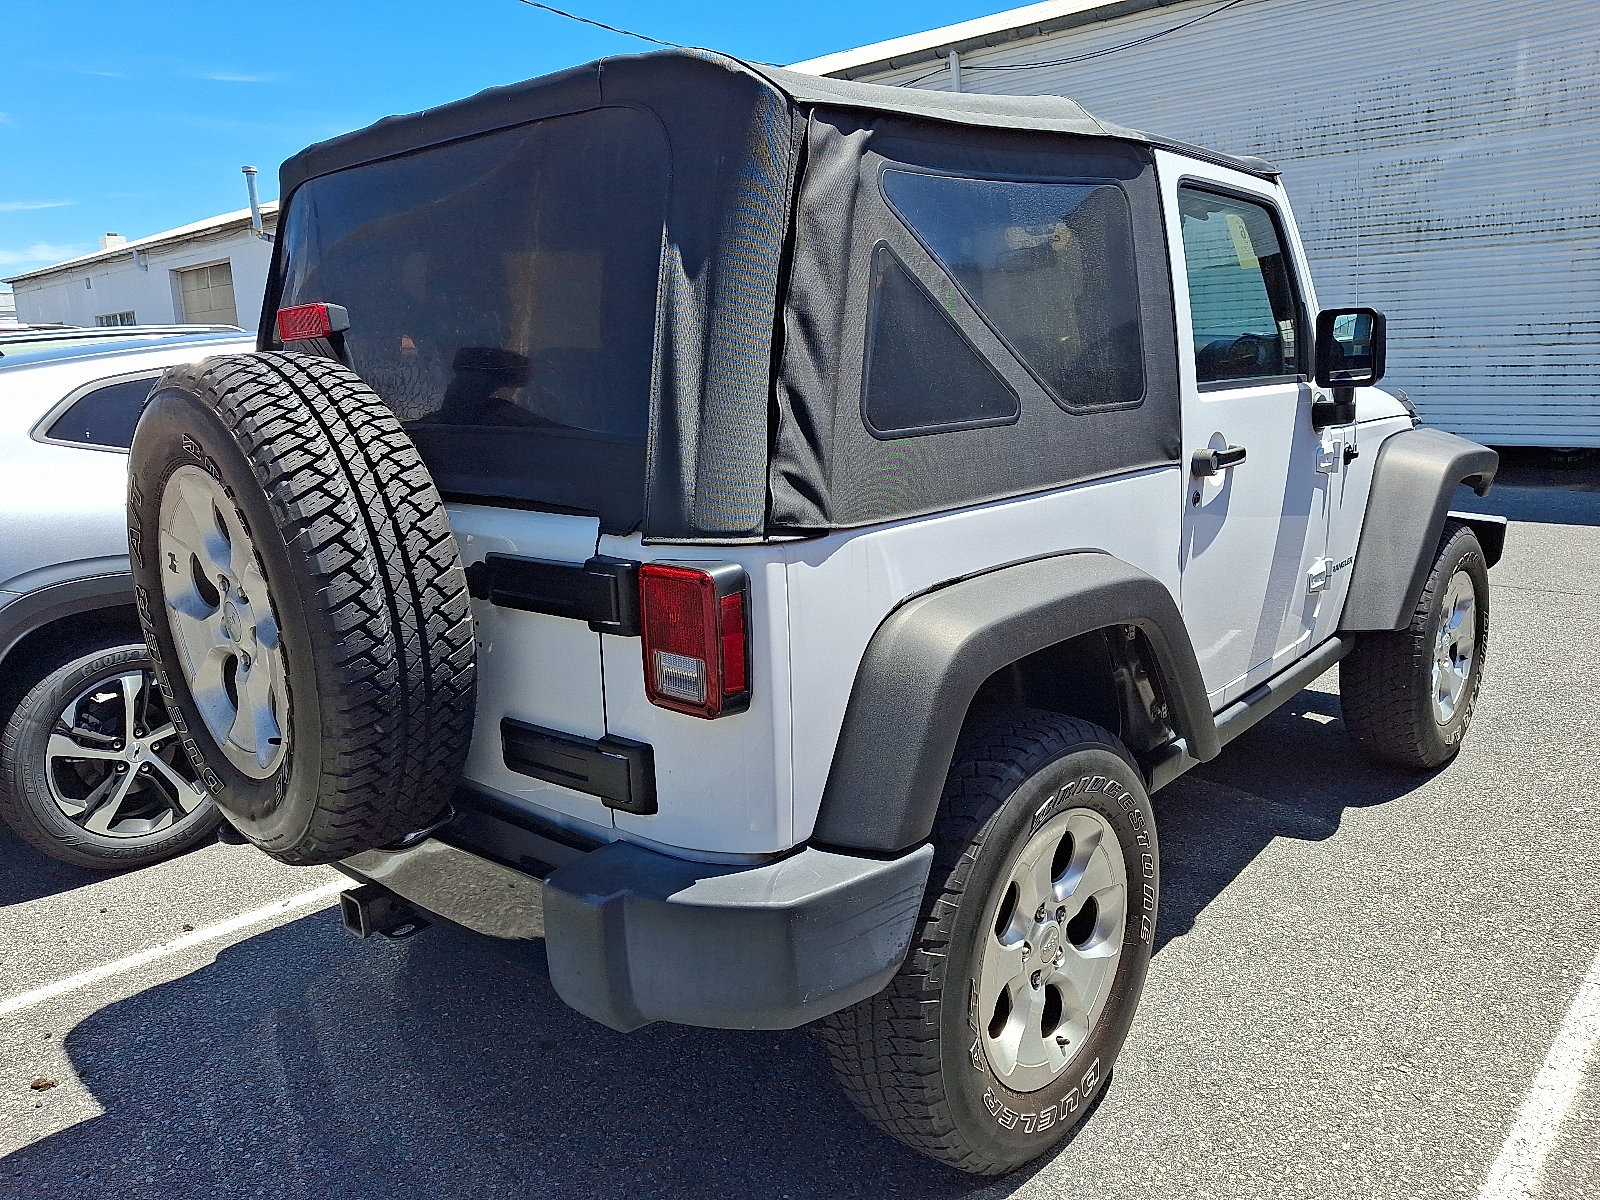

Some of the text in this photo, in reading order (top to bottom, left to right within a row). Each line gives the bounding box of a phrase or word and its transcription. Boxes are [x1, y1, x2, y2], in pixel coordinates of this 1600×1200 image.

[129, 473, 143, 569] A/T
[1332, 556, 1353, 573] RANGLER
[135, 584, 225, 796] DUELER
[1028, 775, 1155, 945] BRIDGESTONE
[968, 977, 1100, 1134] DUELER A/T
